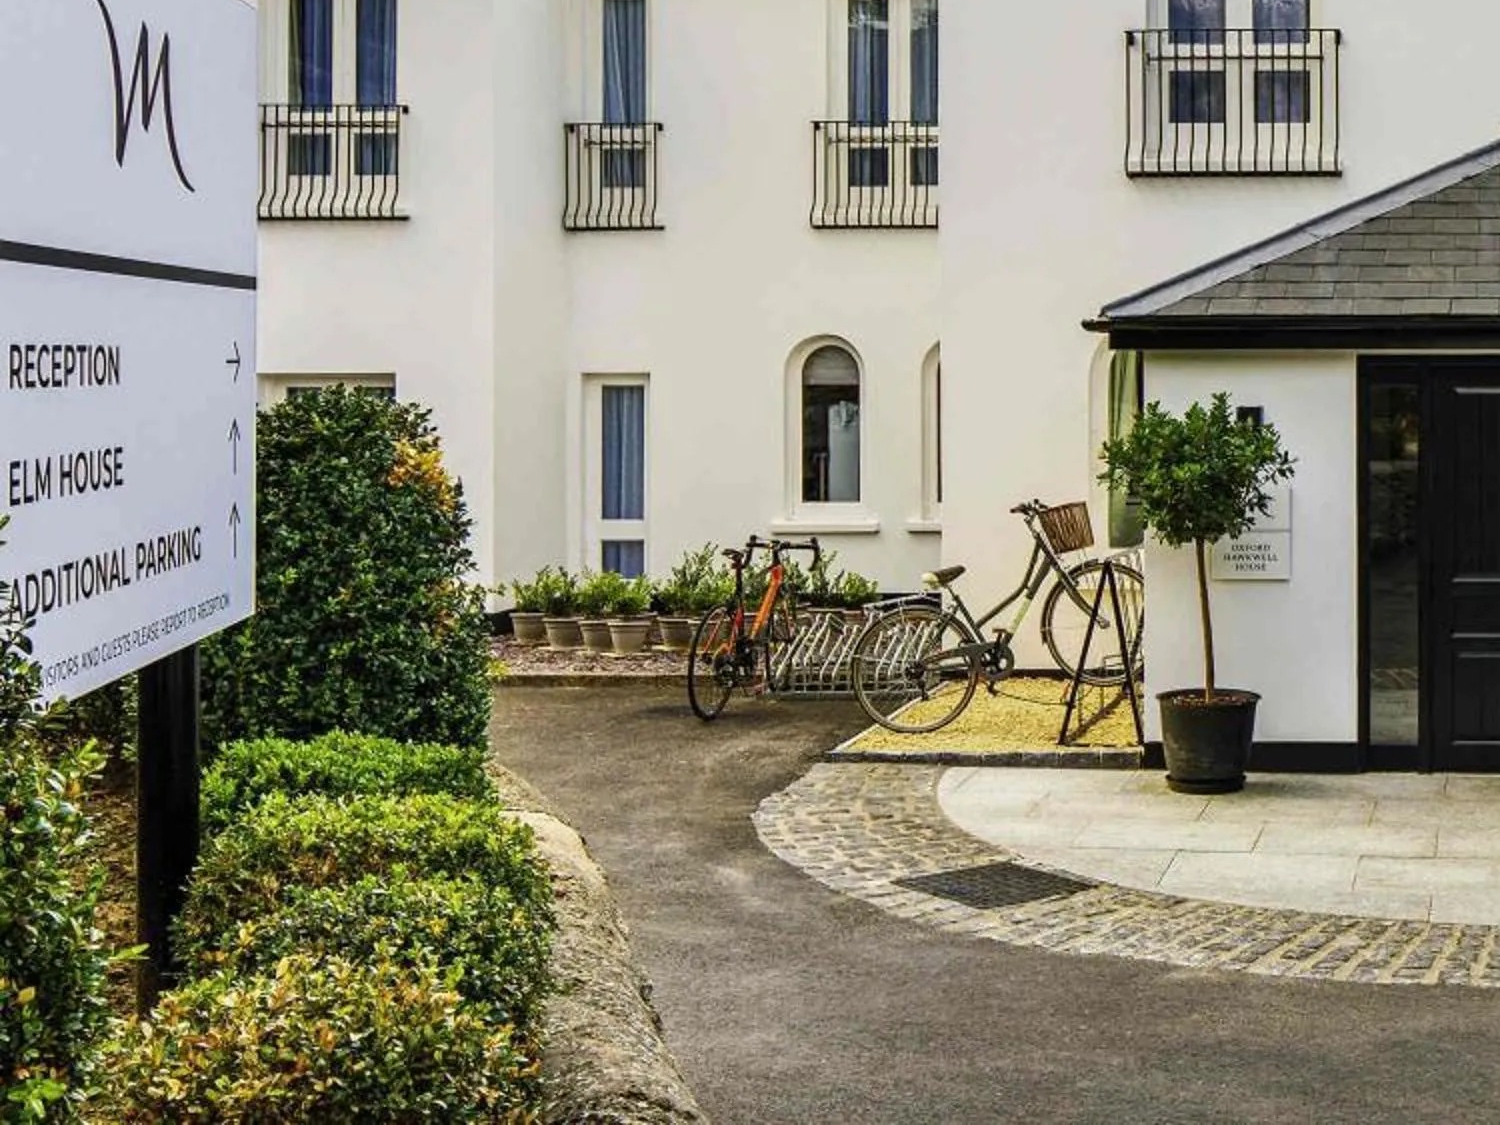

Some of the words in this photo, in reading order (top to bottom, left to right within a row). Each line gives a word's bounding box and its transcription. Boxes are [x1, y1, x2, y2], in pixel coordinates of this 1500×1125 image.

[9, 344, 121, 389] RECEPTION
[9, 457, 51, 507] ELM
[59, 446, 124, 497] HOUSE
[1231, 544, 1271, 552] OXFORD
[11, 547, 131, 622] ADDITIONAL
[135, 526, 201, 581] PARKING
[1235, 563, 1266, 572] HOUSE
[42, 655, 79, 687] ISITORS
